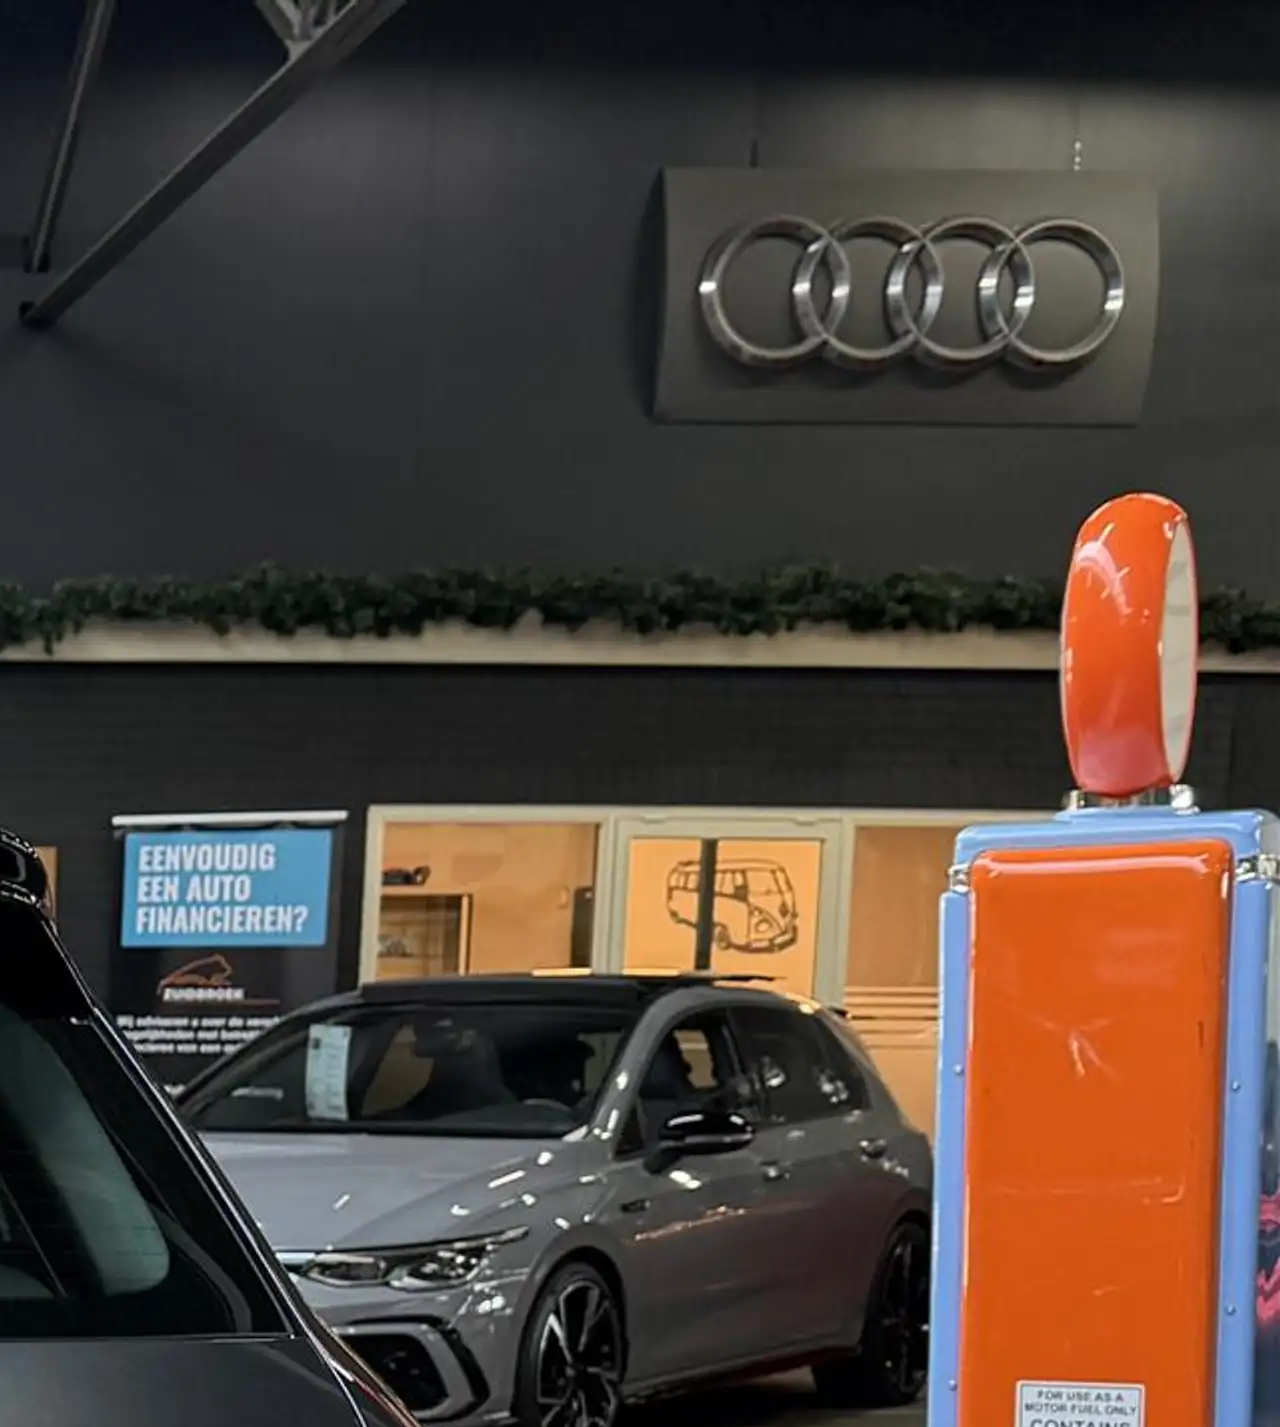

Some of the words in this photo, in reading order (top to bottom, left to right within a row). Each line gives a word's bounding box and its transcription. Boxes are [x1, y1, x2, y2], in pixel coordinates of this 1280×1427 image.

[139, 843, 276, 872] EENVOUDIG
[137, 876, 179, 903] EEN
[187, 875, 251, 902] AUTO
[135, 905, 308, 934] FINANCIEREN?
[1024, 1402, 1068, 1413] MOTOR
[1071, 1404, 1101, 1415] FUEL
[1105, 1405, 1137, 1417] ONLY
[1037, 1390, 1063, 1400] FOR
[1067, 1391, 1091, 1401] USE
[1095, 1392, 1112, 1402] AS
[1116, 1393, 1125, 1402] A
